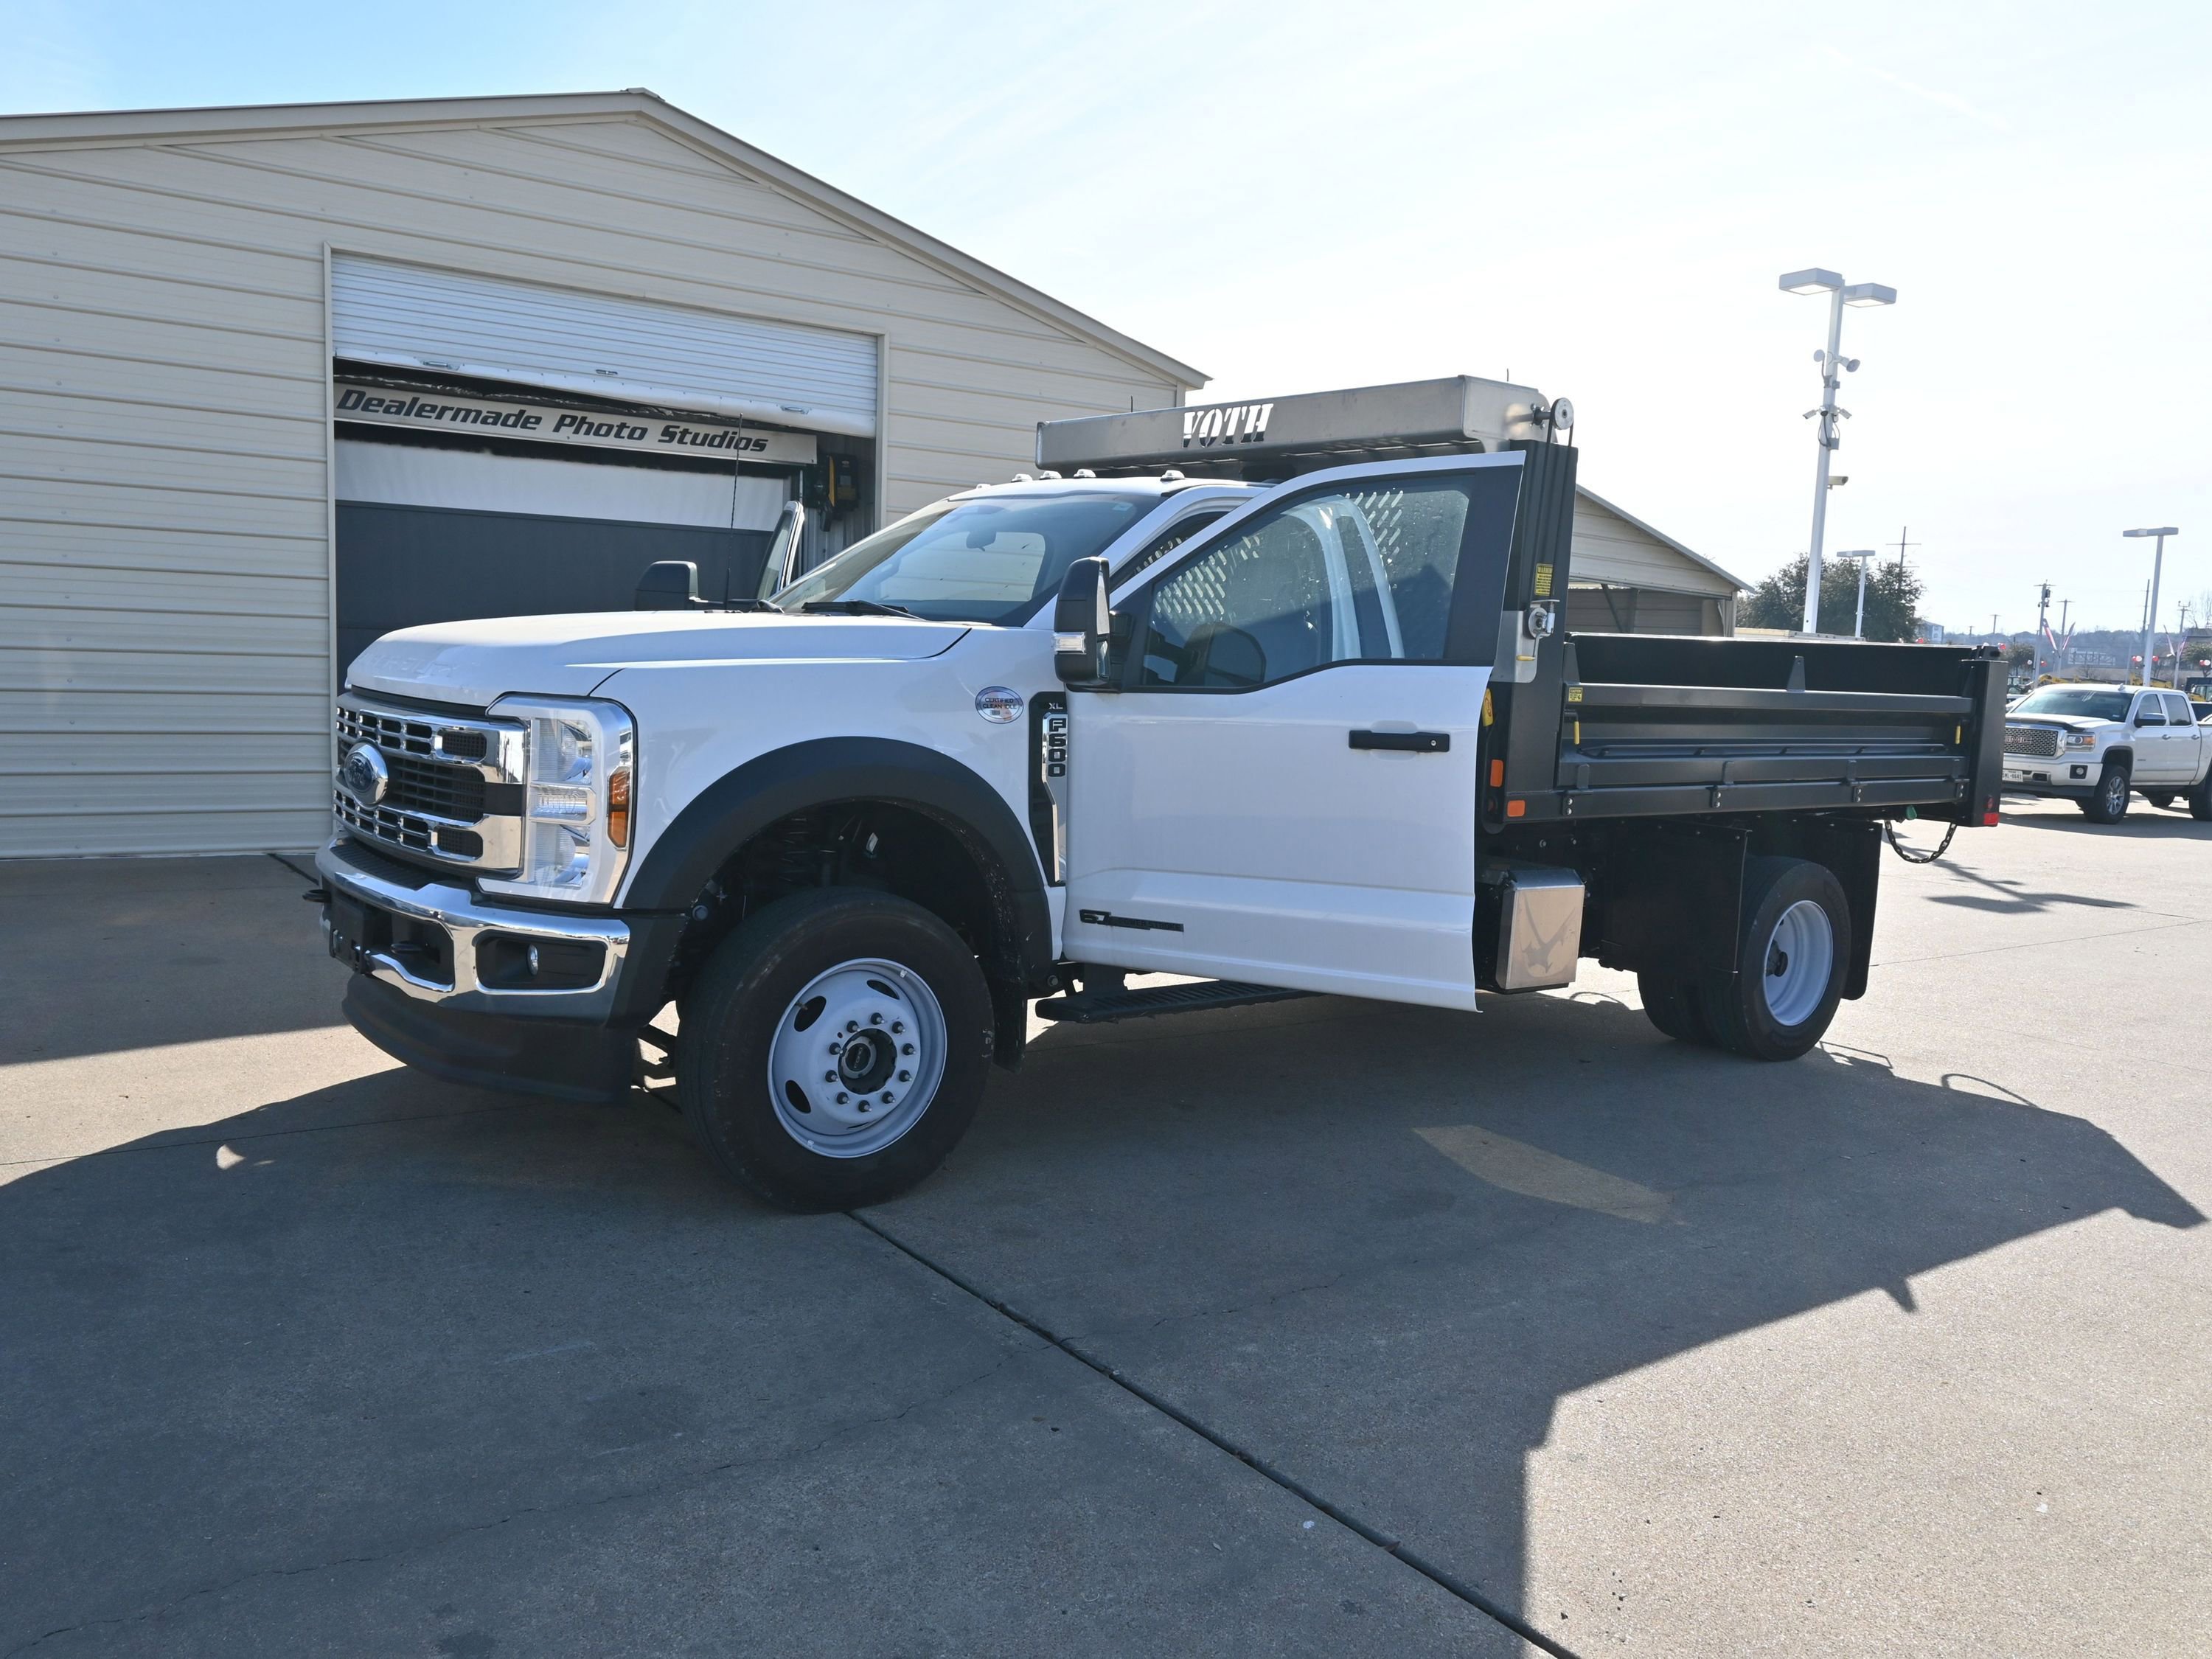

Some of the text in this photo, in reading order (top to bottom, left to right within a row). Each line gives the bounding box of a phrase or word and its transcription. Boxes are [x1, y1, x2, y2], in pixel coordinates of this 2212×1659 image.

[337, 389, 769, 452] Dealermade Photo Studios
[1183, 403, 1273, 448] VOTH
[1048, 718, 1067, 777] F600
